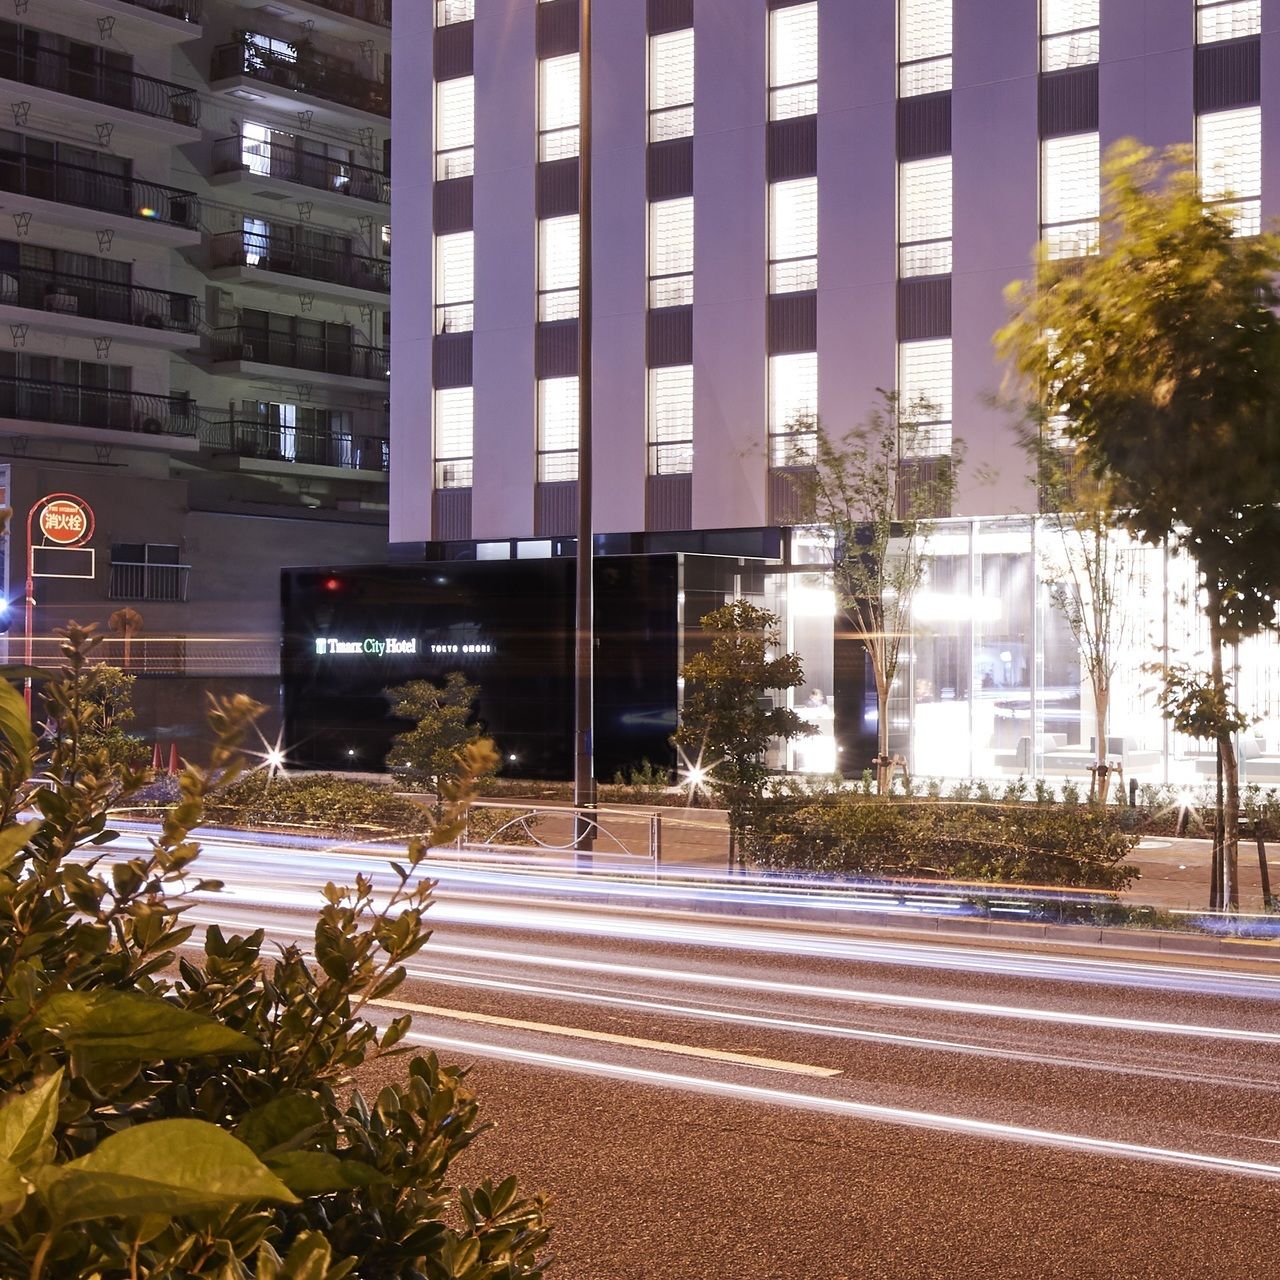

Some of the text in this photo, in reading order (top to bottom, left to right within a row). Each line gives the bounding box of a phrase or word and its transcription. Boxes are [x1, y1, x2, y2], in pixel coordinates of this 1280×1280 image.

[45, 513, 82, 531] 消火栓
[363, 638, 386, 657] City
[385, 638, 417, 654] Hotel
[430, 644, 458, 653] TOKYO
